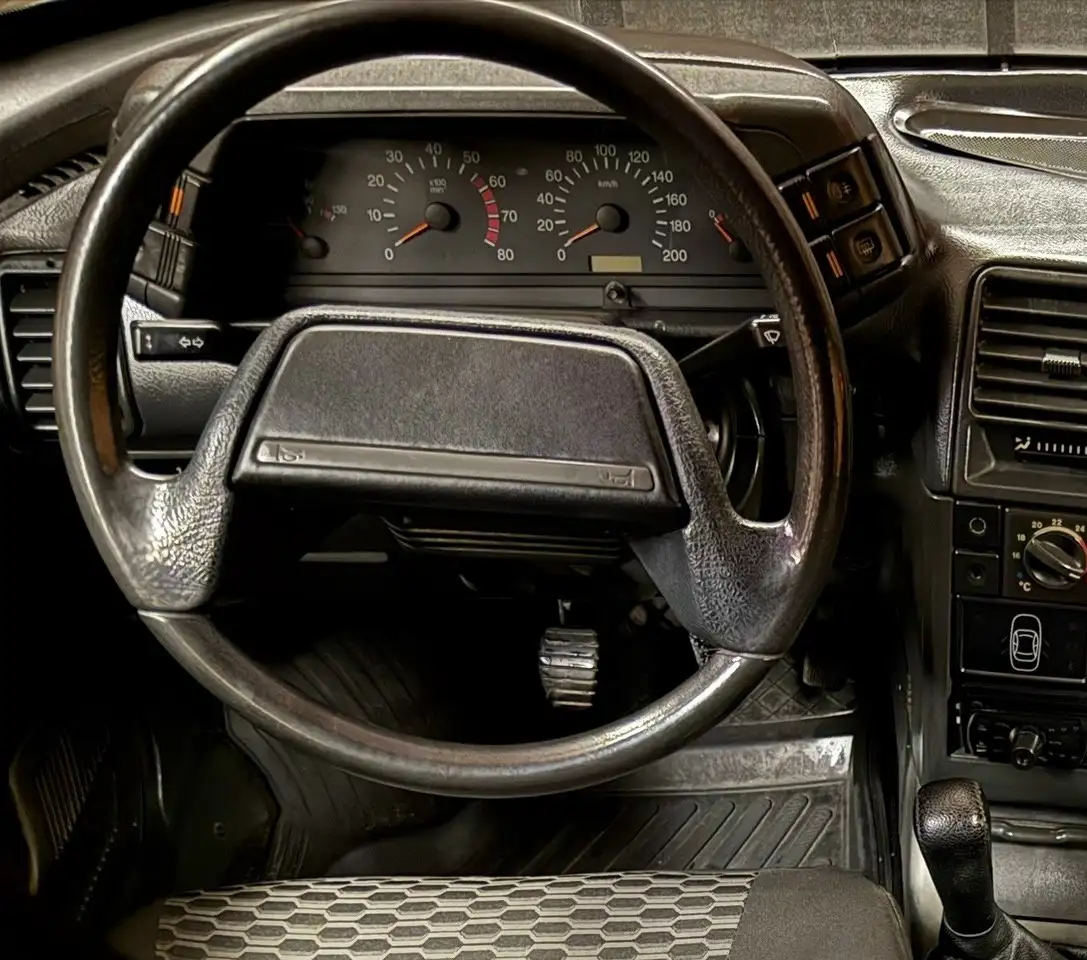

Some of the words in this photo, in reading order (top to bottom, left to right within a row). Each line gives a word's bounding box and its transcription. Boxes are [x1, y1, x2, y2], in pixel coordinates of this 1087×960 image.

[425, 142, 442, 155] 40
[595, 144, 616, 157] 100
[386, 151, 403, 163] 30
[463, 151, 480, 164] 50
[566, 151, 583, 163] 80
[628, 151, 650, 163] 120
[367, 174, 385, 187] 20
[489, 175, 506, 188] 60
[545, 169, 563, 182] 60
[651, 171, 674, 183] 140
[598, 180, 618, 188] km/h
[536, 192, 554, 205] 40
[665, 193, 687, 206] 160
[367, 209, 382, 222] 10
[501, 210, 518, 222] 70
[537, 219, 554, 231] 20
[670, 220, 691, 233] 180
[384, 248, 394, 261] 0
[497, 248, 515, 261] 80
[557, 248, 567, 262] 0
[662, 249, 688, 262] 200
[1031, 521, 1043, 529] 20
